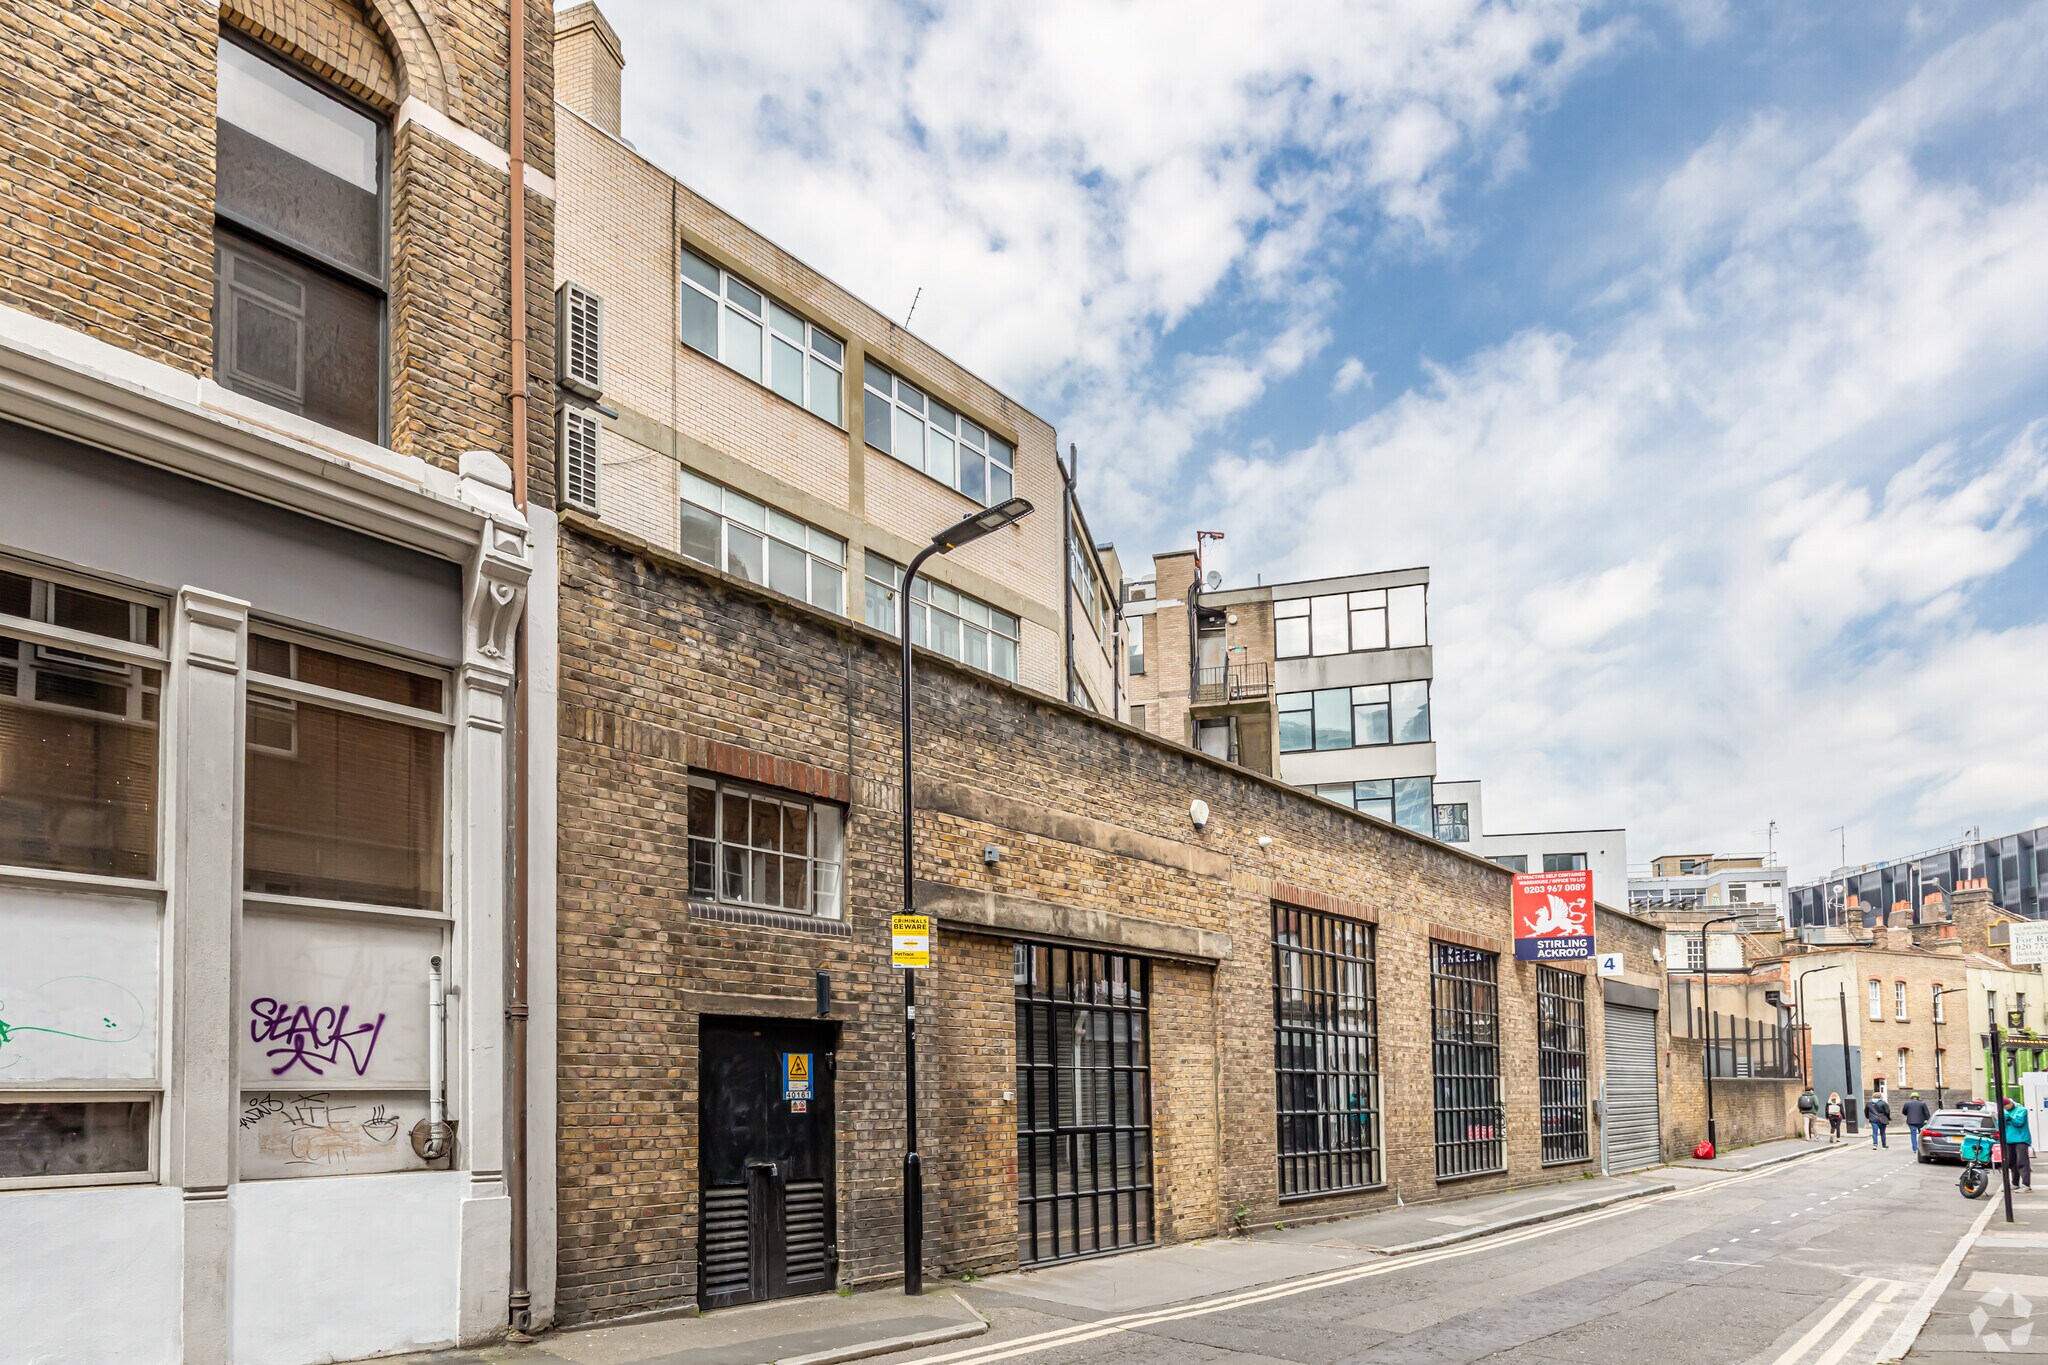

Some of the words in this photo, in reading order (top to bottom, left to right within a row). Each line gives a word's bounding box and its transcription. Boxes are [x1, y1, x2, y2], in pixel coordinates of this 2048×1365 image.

[1537, 939, 1587, 948] STIRLING
[1537, 948, 1587, 957] ACKROYD
[1604, 958, 1615, 970] 4
